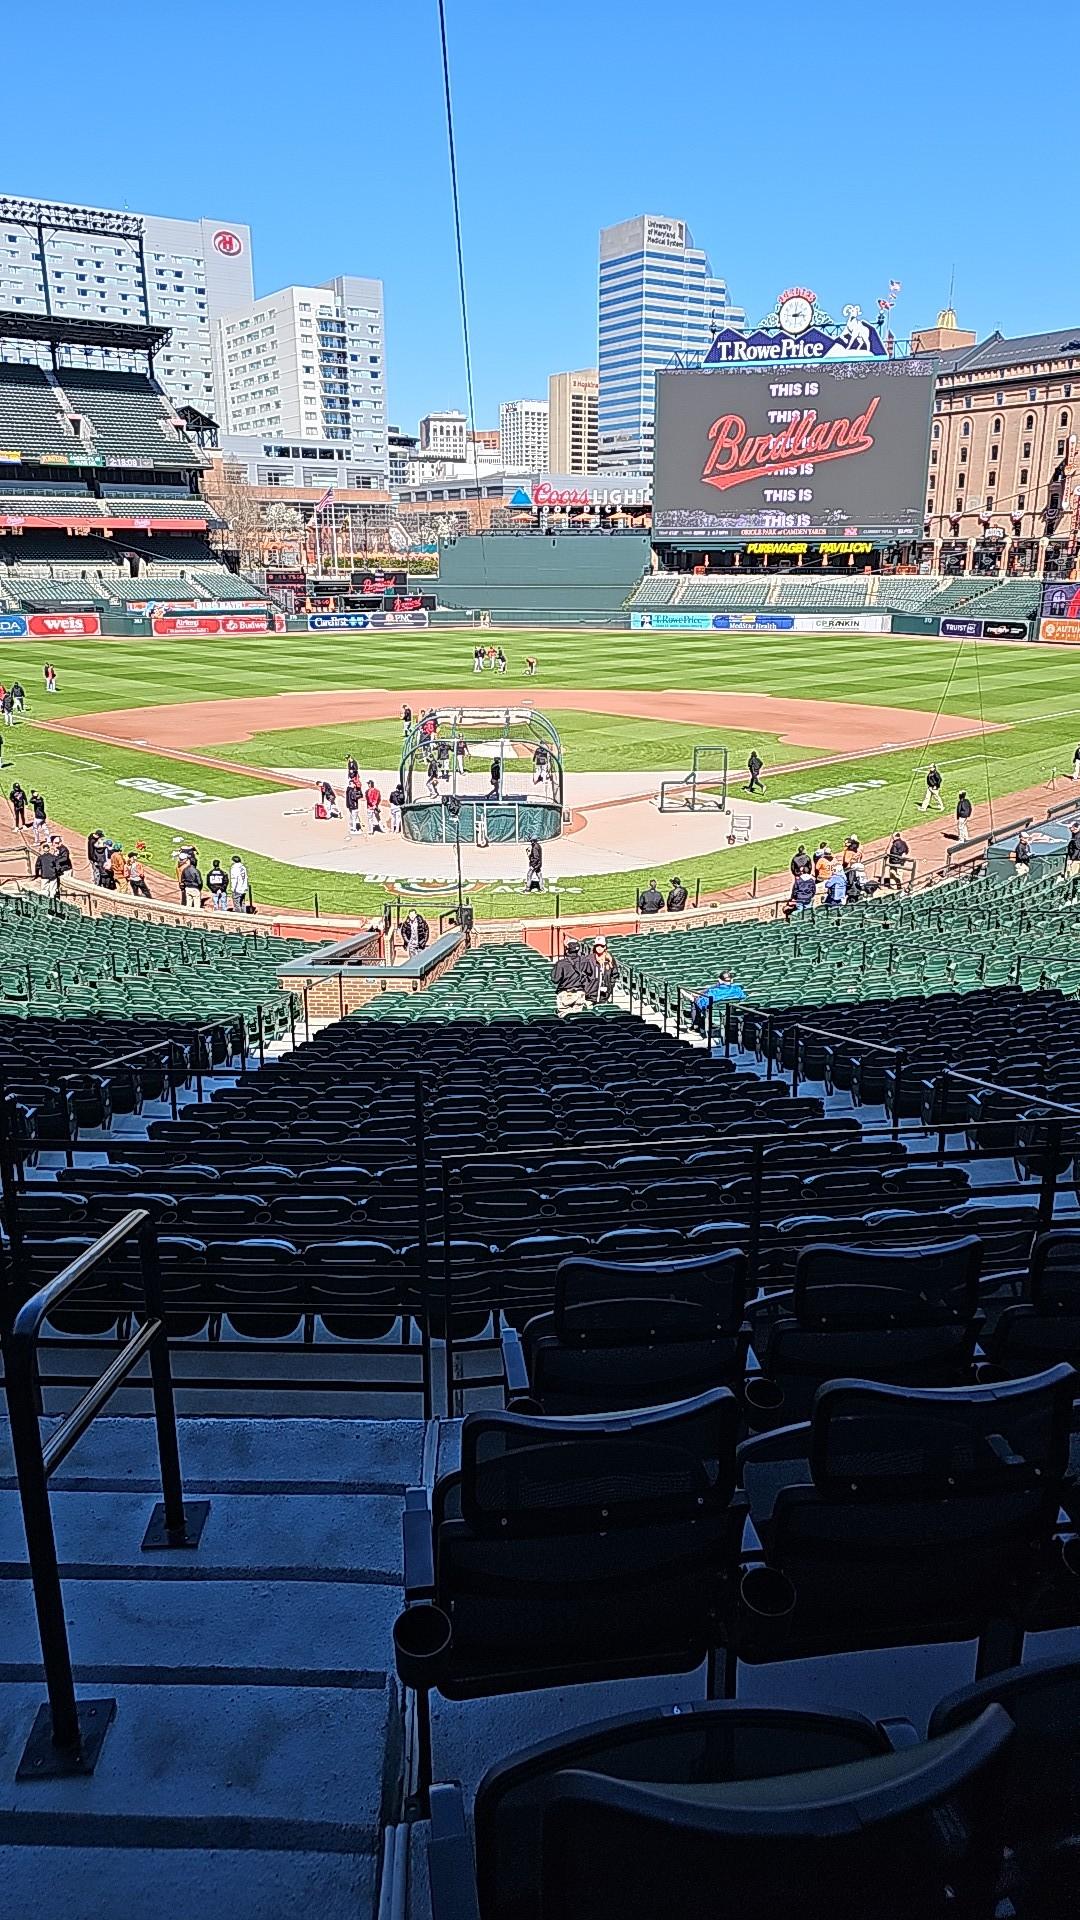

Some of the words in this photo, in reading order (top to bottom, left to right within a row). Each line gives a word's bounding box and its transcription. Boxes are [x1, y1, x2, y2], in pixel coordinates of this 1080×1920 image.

[648, 220, 672, 231] University
[654, 230, 676, 239] Maryland
[647, 236, 666, 245] Medical
[769, 383, 802, 396] THIS
[804, 382, 819, 396] IS
[767, 410, 801, 424] THIS
[703, 396, 881, 475] Birdland
[800, 463, 814, 475] IS
[532, 482, 592, 506] Coors
[592, 487, 649, 505] LIGHT
[764, 490, 797, 502] THIS
[798, 489, 813, 501] IS
[532, 505, 572, 514] ROOF
[583, 504, 623, 513] DECK
[763, 516, 796, 528] THIS
[797, 515, 812, 527] IS
[747, 542, 808, 554] PUREWAGER
[819, 542, 873, 553] PAVILION
[43, 616, 84, 630] weis
[315, 616, 349, 627] CareFirst
[394, 614, 412, 622] PNC
[729, 622, 755, 630] MedStar
[756, 622, 776, 630] Health
[945, 623, 967, 632] TRUIST
[1056, 625, 1080, 633] AUTU
[490, 885, 584, 894] Abe
[673, 1705, 681, 1715] 6
